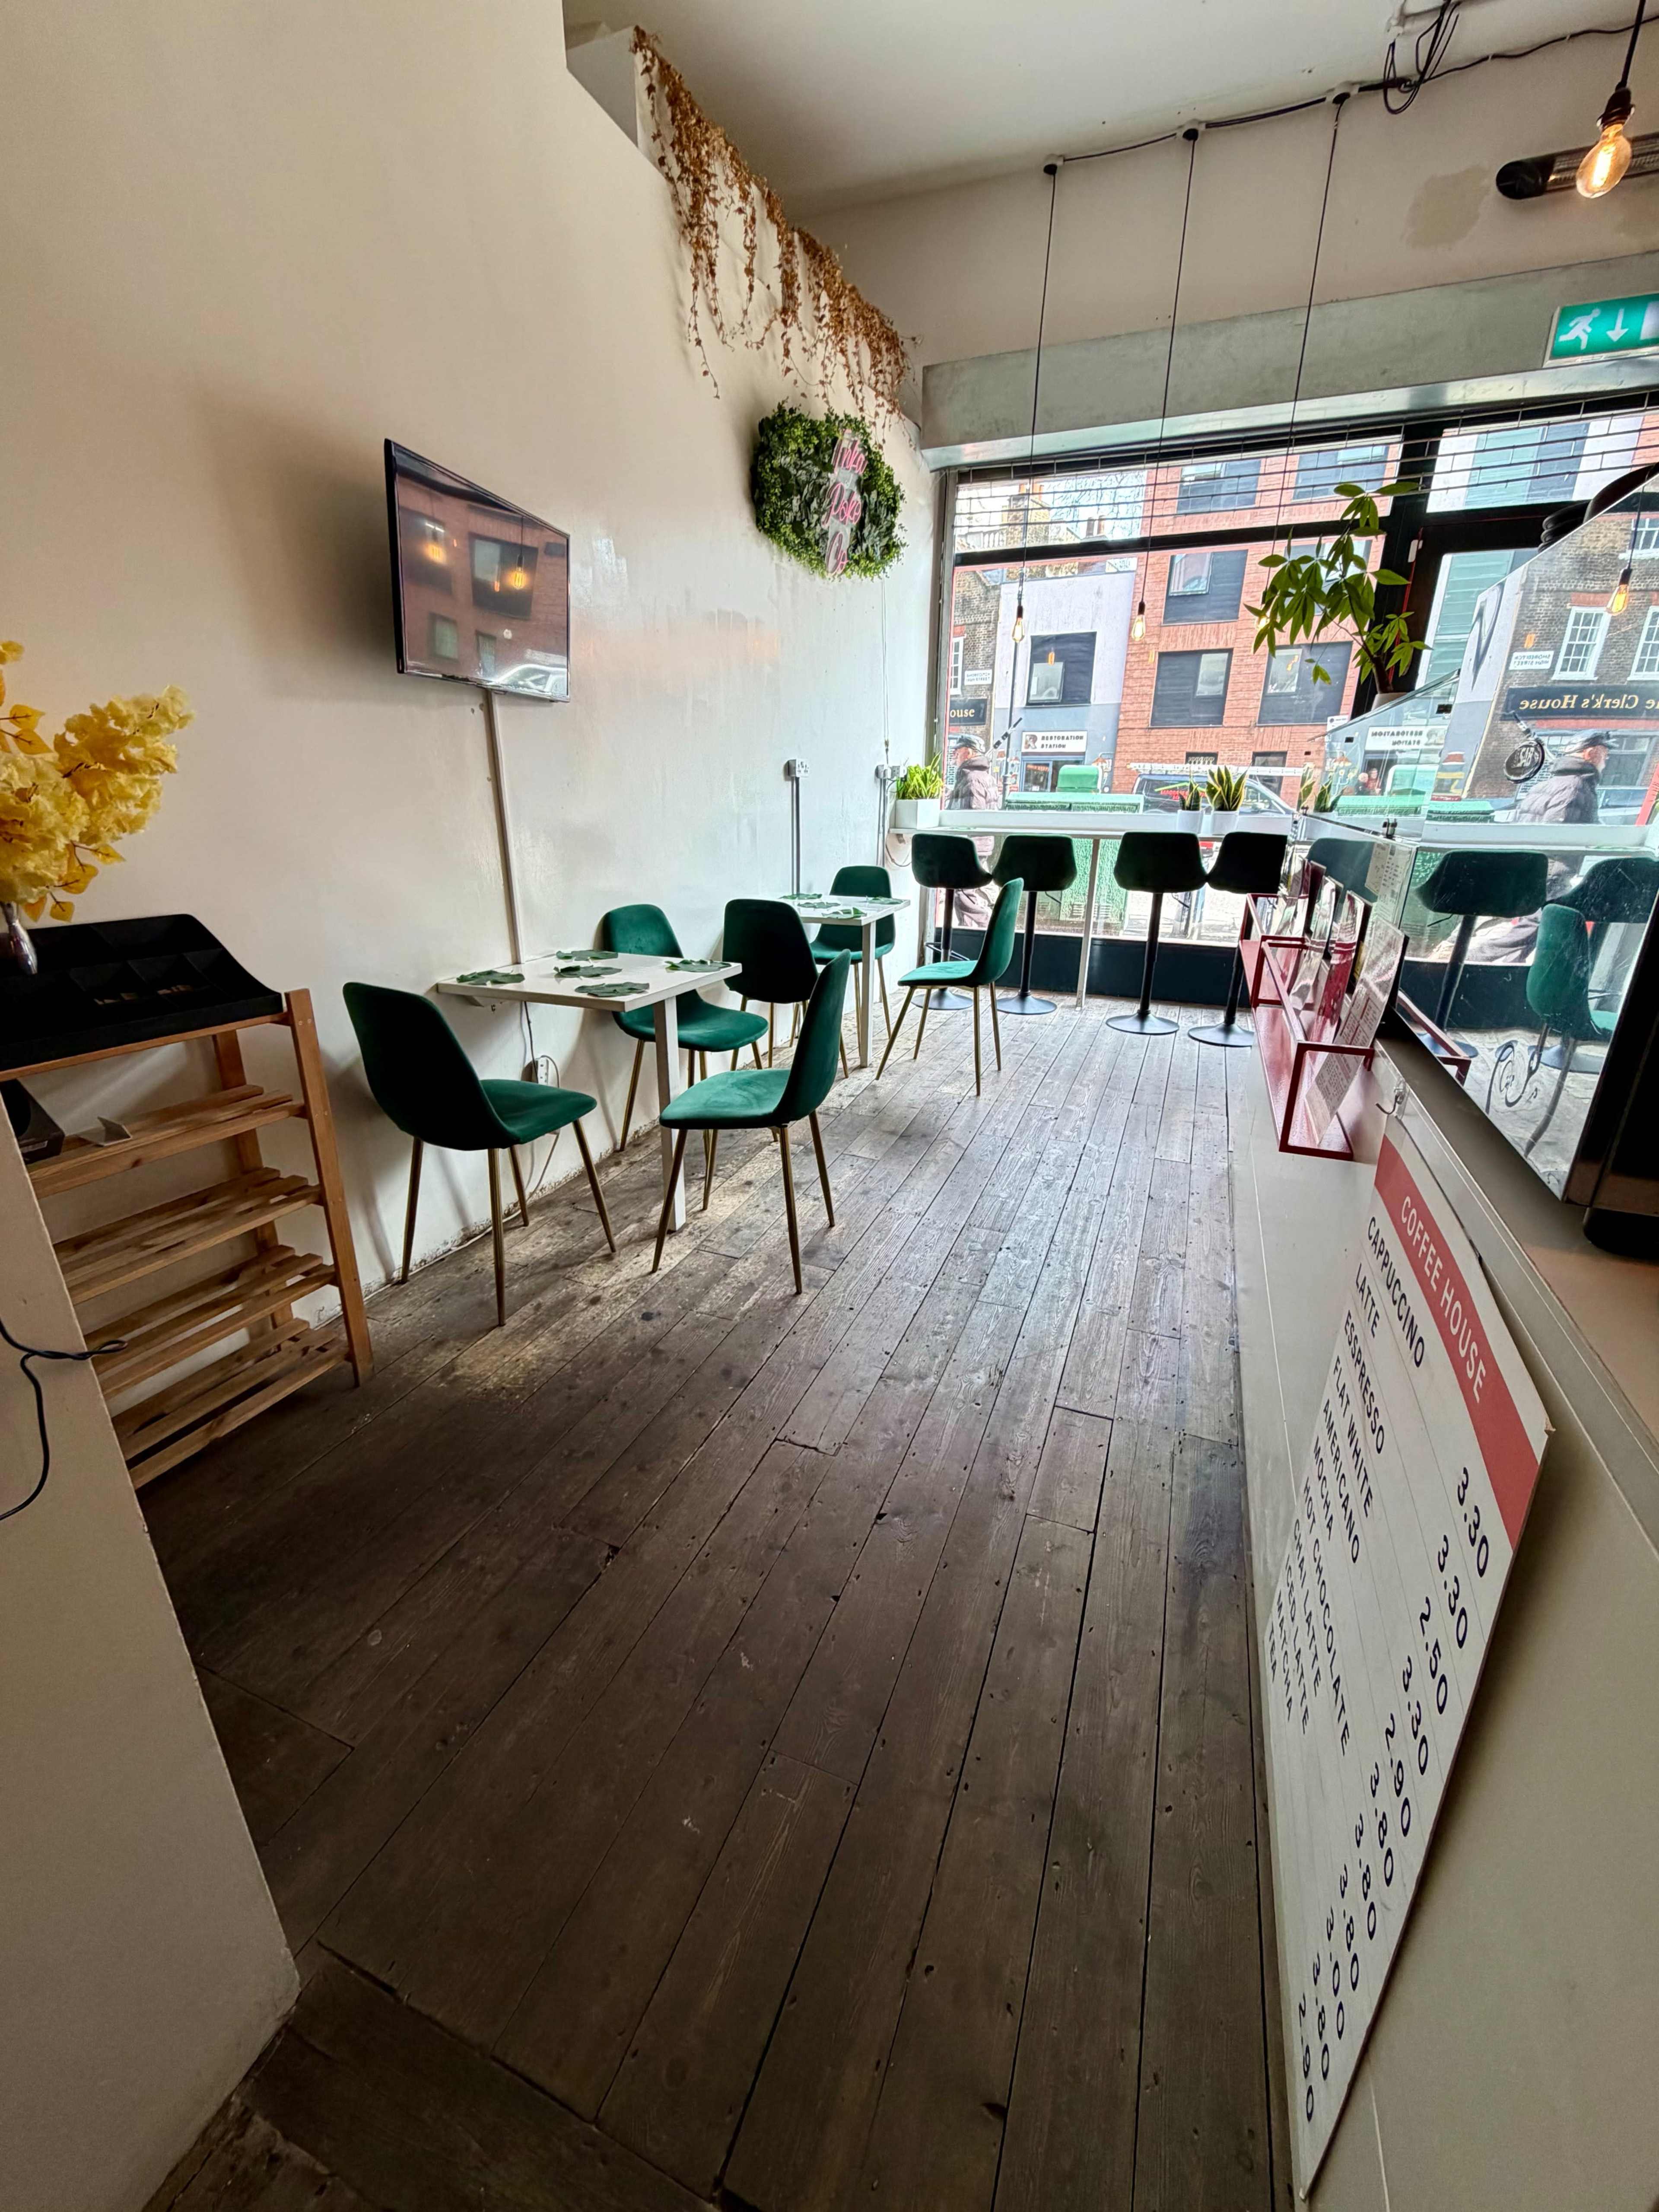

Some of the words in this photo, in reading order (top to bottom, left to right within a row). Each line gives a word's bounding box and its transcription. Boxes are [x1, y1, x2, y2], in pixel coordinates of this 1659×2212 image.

[821, 483, 861, 525] Poke
[950, 709, 975, 718] ouse
[1356, 1263, 1379, 1338] LATTE
[1438, 1535, 1468, 1649] 3.30
[1368, 1217, 1424, 1368] CAPPUCCINO
[1458, 1467, 1489, 1578] 3.30
[1402, 1196, 1443, 1292] COFFEE
[1440, 1278, 1486, 1404] HOUSE
[1304, 1477, 1316, 1534] HOT
[1313, 1538, 1349, 1756] CHOCOLATE
[1355, 1813, 1376, 1941] 3.80
[1315, 1436, 1333, 1541] MOCHA
[1370, 1762, 1393, 1887] 3.80
[1323, 1399, 1359, 1563] AMERICANO
[1385, 1713, 1411, 1837] 2.90
[1334, 1356, 1350, 1418] FLAT
[1348, 1414, 1373, 1518] WHITE
[1403, 1655, 1428, 1776] 3.30
[1344, 1310, 1384, 1454] ESSPRESSO
[1420, 1596, 1448, 1715] 2.50
[1278, 1589, 1292, 1722] MATCHA
[1313, 1952, 1329, 2081] 3.80
[1286, 1554, 1296, 1623] ICED
[1294, 1626, 1309, 1735] LATTE
[1326, 1906, 1344, 2040] 3.00
[1294, 1518, 1306, 1588] CHAI
[1304, 1589, 1321, 1697] LATTE
[1340, 1863, 1359, 1991] 3.80
[1299, 1993, 1314, 2123] 2.90
